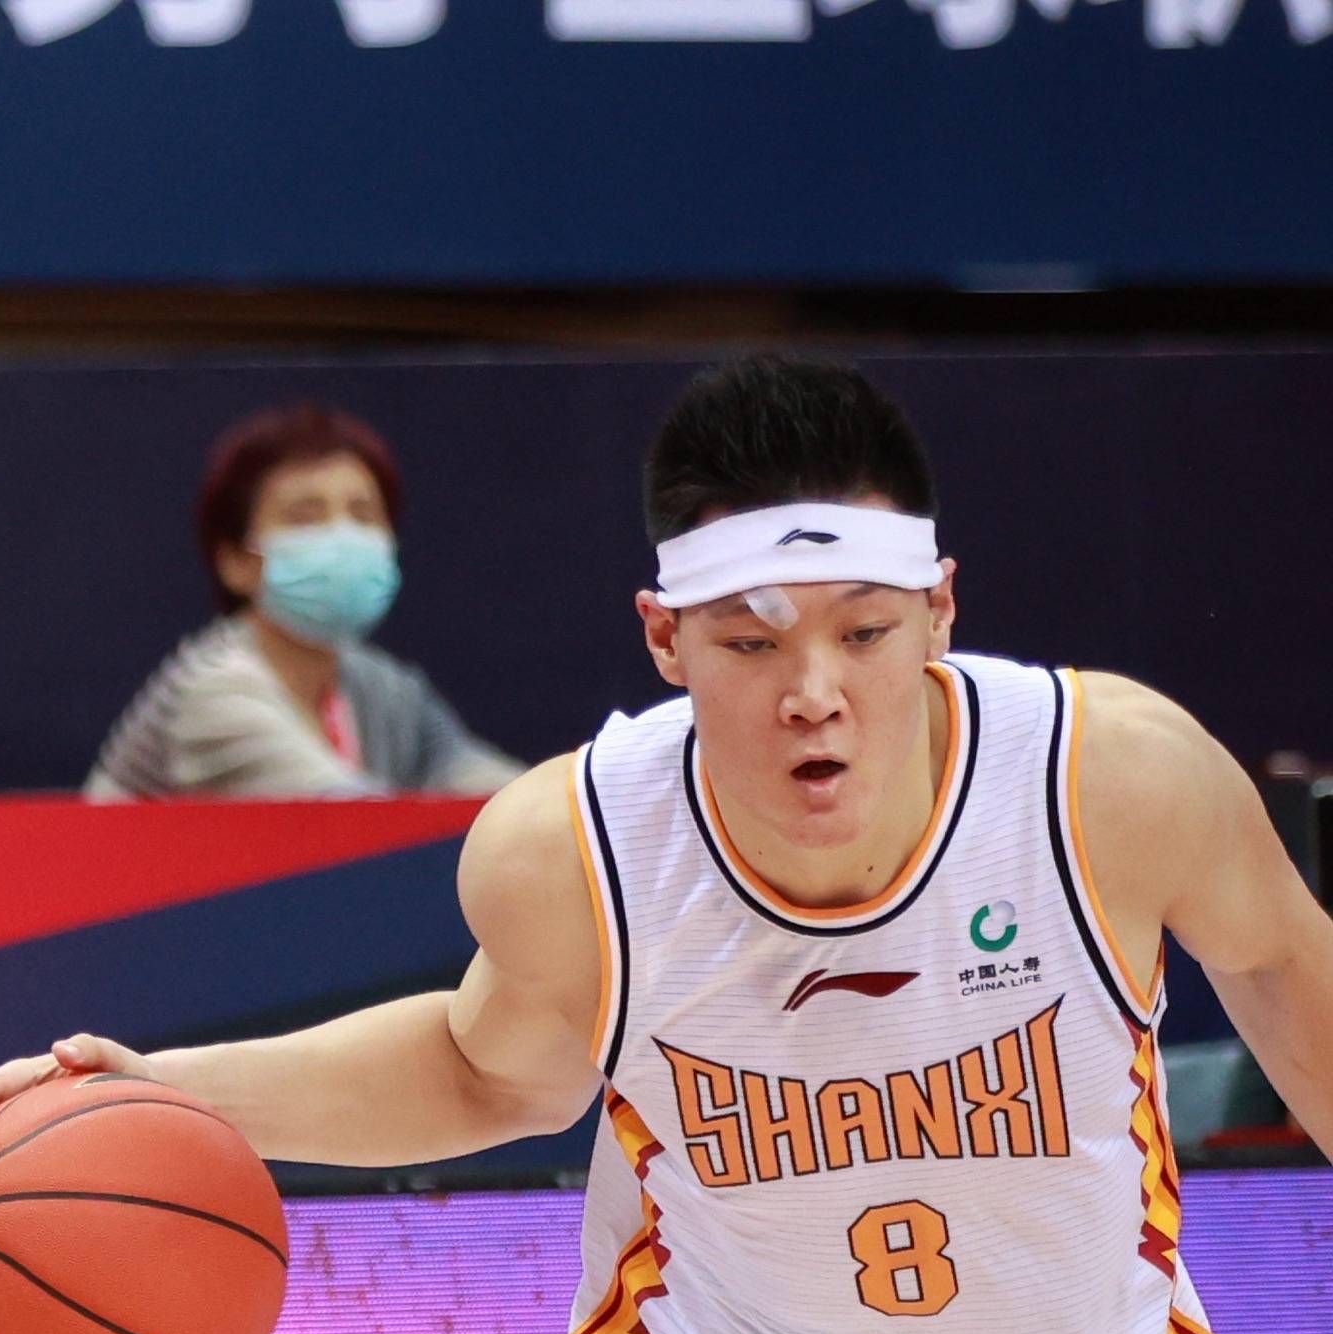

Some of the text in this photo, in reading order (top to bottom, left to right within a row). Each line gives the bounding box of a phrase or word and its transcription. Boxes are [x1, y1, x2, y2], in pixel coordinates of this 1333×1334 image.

[958, 956, 1041, 984] 中国人寿
[961, 973, 1043, 996] CHINA LIFE
[651, 993, 1070, 1187] SHANXI
[847, 1199, 958, 1316] 8
